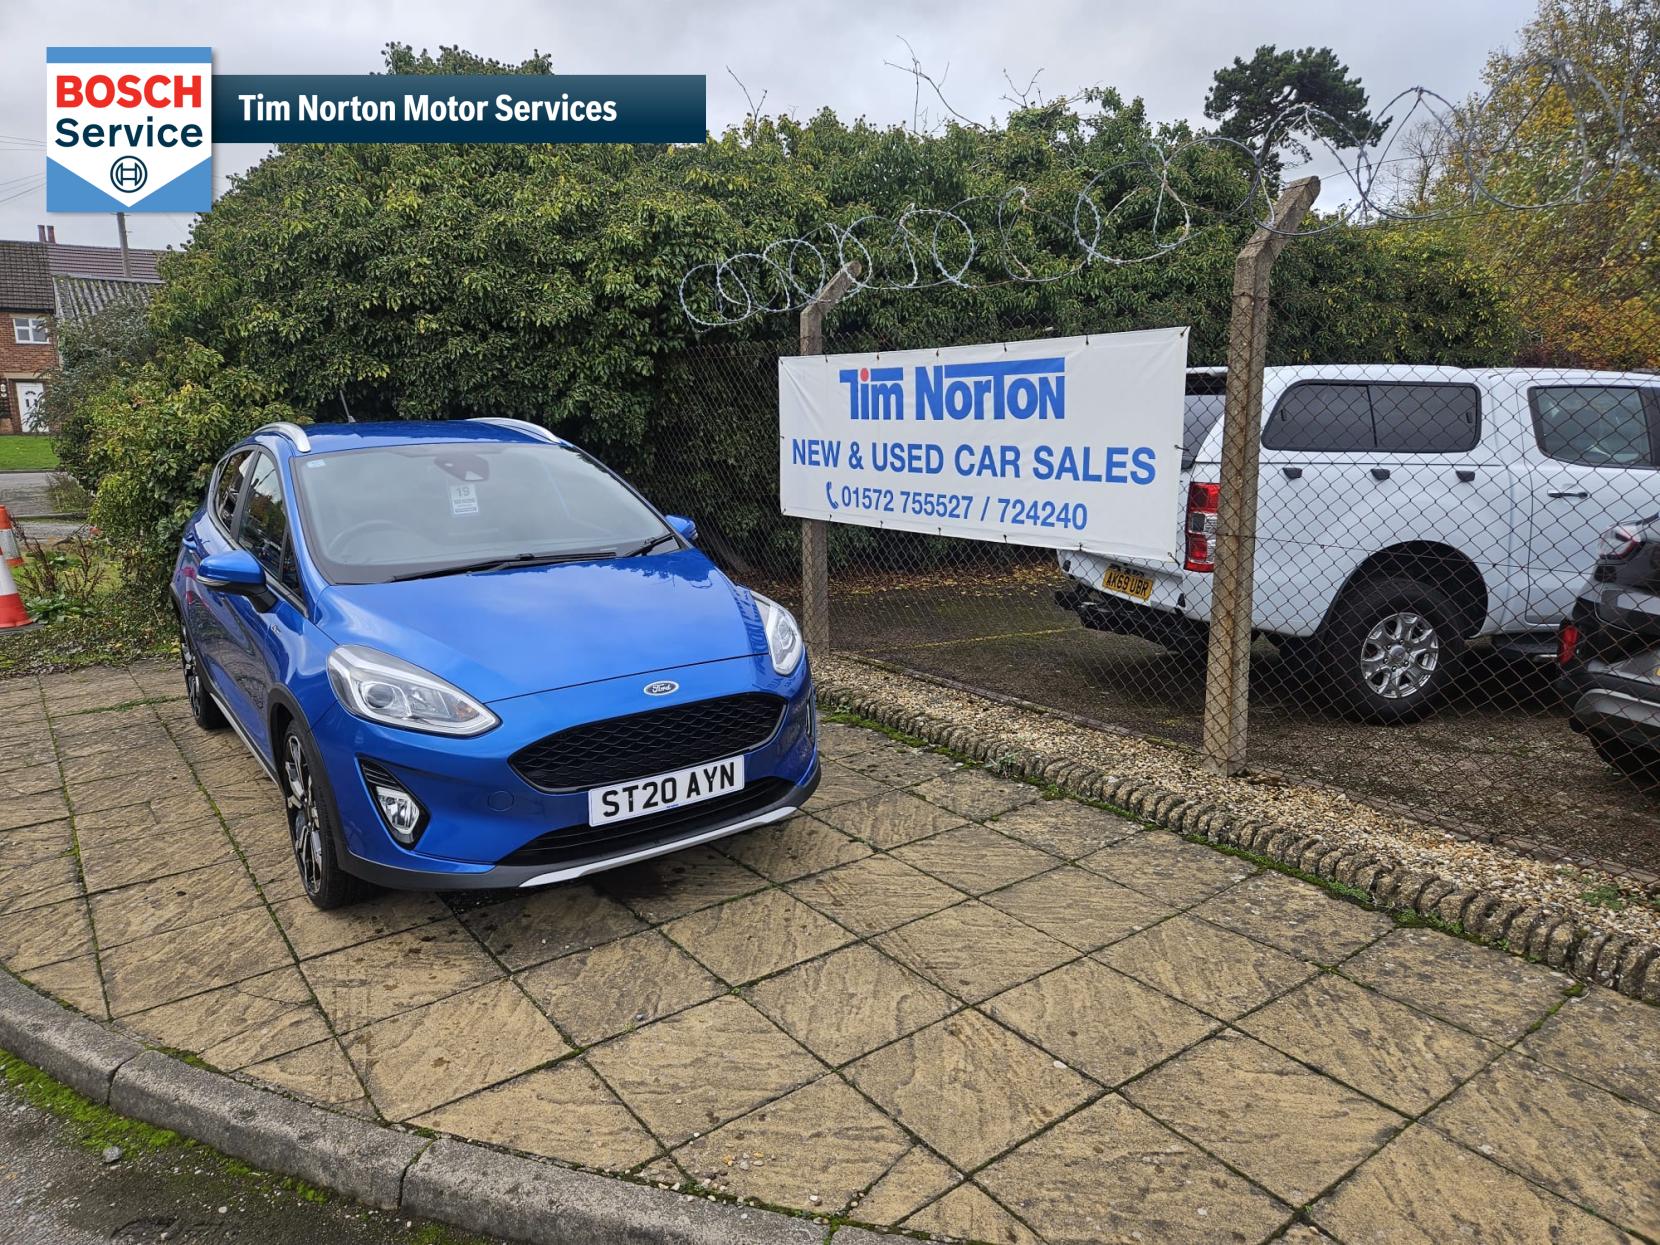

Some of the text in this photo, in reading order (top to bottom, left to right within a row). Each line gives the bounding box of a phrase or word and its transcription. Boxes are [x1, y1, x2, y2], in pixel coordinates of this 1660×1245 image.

[839, 366, 905, 421] Tim
[792, 438, 1157, 486] NEW & USED CAR SALES
[841, 485, 1088, 531] 01572 755527 / 724240
[1106, 572, 1149, 596] AK69 UBR
[652, 683, 672, 693] Ford
[601, 761, 735, 818] ST20 AYN
